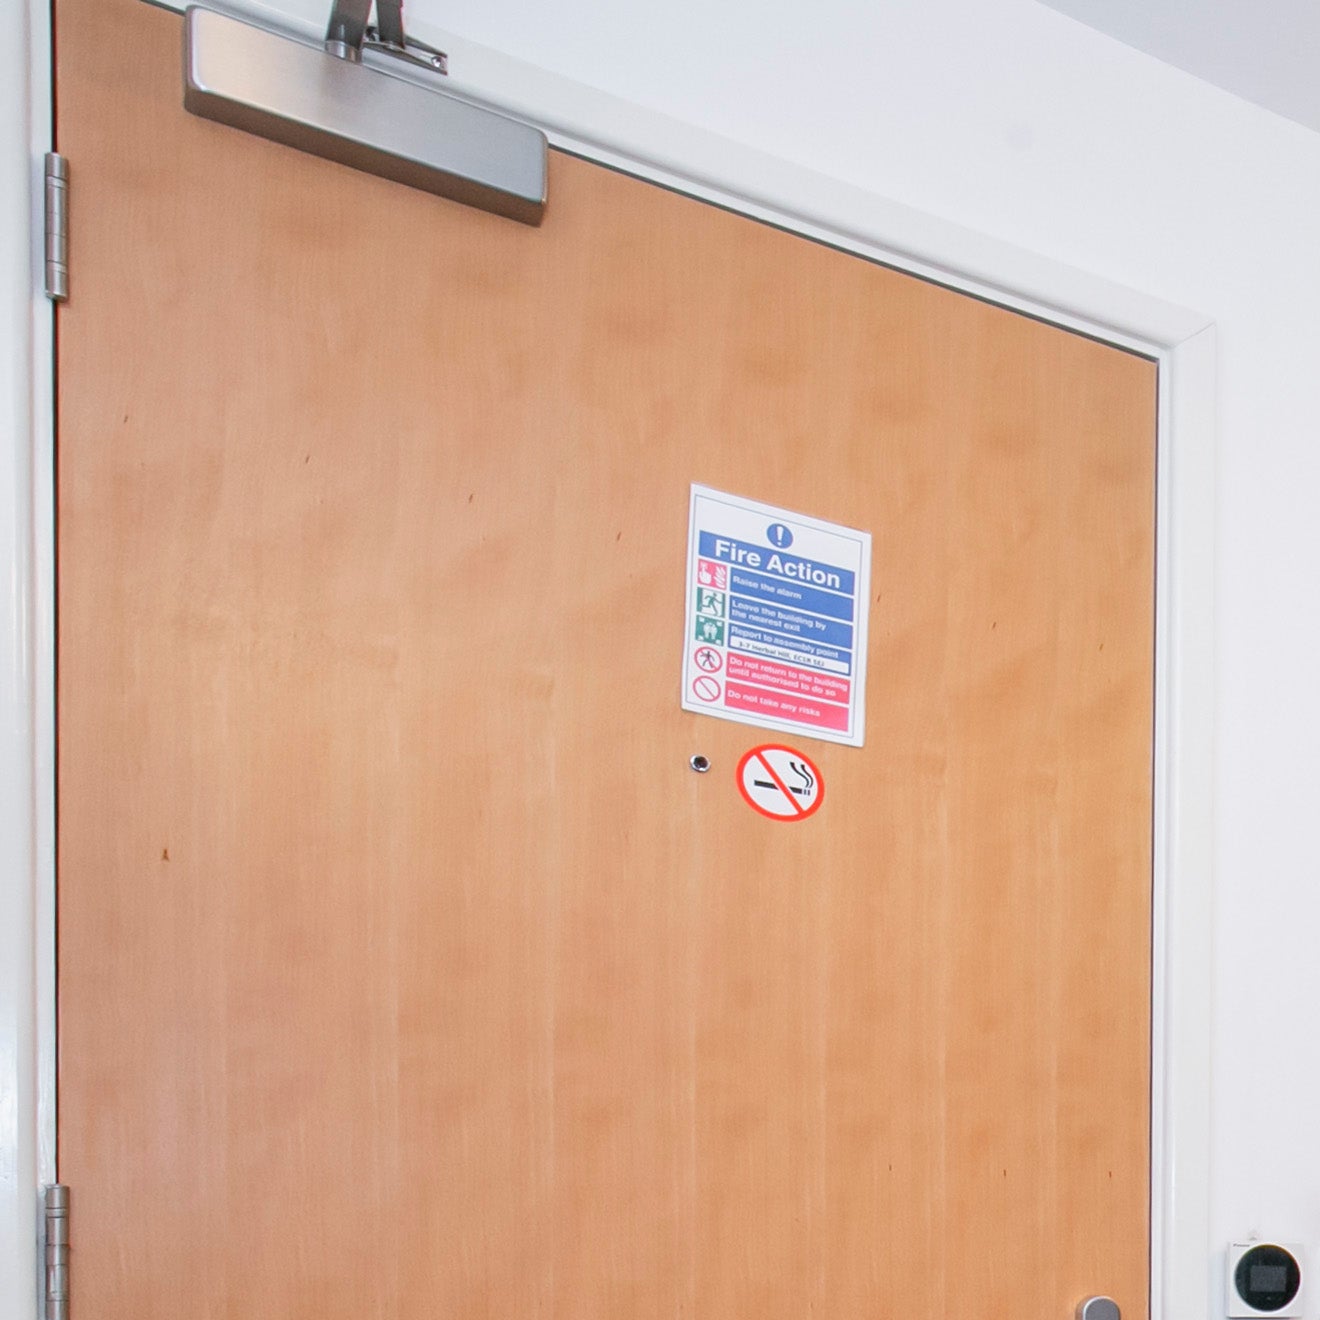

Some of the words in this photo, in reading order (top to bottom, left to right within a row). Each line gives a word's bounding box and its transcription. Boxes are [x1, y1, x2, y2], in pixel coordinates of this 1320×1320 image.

[715, 539, 761, 567] Fire
[766, 554, 840, 589] Action
[733, 575, 759, 589] Raise
[760, 581, 775, 593] the
[777, 587, 802, 600] alarm
[731, 609, 747, 619] the
[748, 613, 781, 627] nearest
[784, 621, 801, 632] exit
[732, 600, 759, 613] Leave
[761, 607, 777, 617] the
[777, 611, 814, 628] building
[815, 620, 827, 631] by
[731, 626, 761, 640] Report
[763, 632, 773, 642] to
[773, 636, 815, 654] assembly
[816, 646, 839, 659] point
[728, 667, 750, 677] until
[751, 671, 799, 688] authorised
[801, 682, 810, 691] to
[811, 685, 823, 694] do
[825, 688, 836, 696] so
[730, 657, 743, 666] Do
[744, 660, 759, 670] not
[760, 663, 786, 676] return
[788, 670, 797, 679] to
[799, 672, 812, 683] the
[814, 676, 848, 692] building
[728, 690, 741, 699] Do
[743, 693, 758, 703] not
[760, 697, 779, 708] take
[780, 702, 797, 713] any
[799, 707, 820, 716] risks
